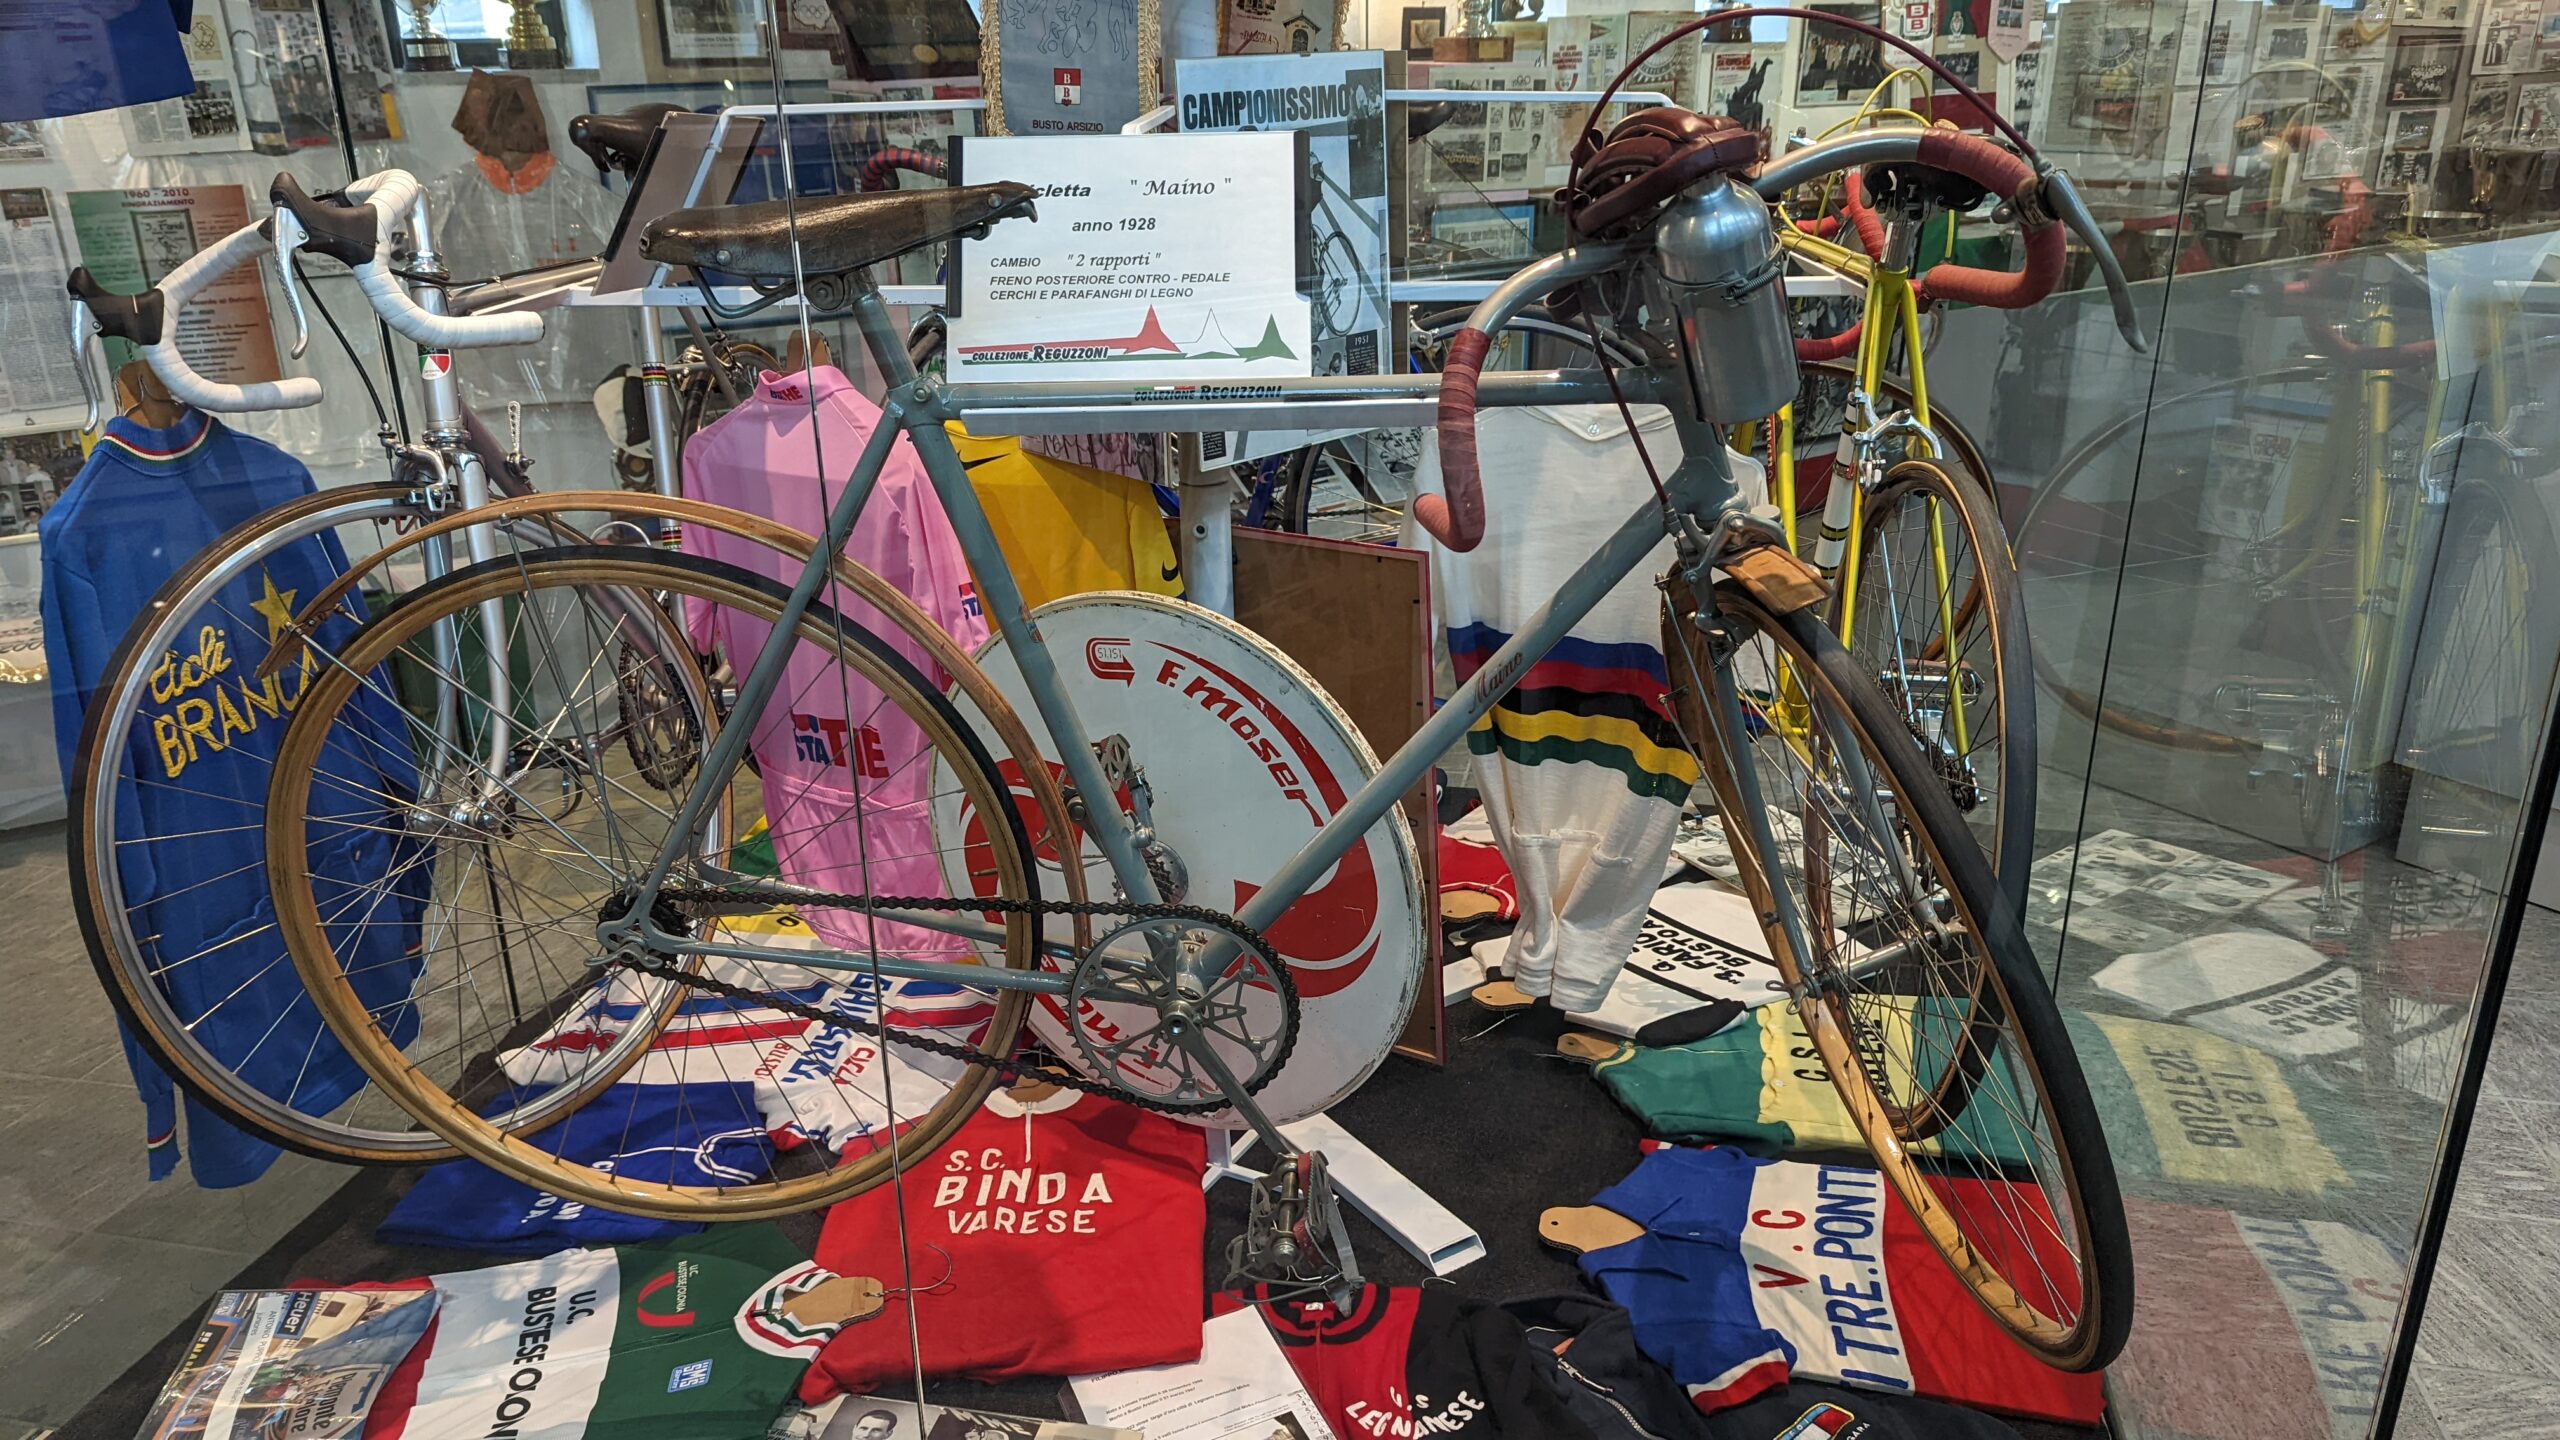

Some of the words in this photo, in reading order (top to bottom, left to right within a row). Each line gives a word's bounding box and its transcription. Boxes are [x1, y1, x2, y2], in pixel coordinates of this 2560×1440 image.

[1910, 3, 1925, 16] B
[1911, 19, 1924, 30] B
[1063, 72, 1072, 84] B
[1063, 86, 1071, 97] B
[1183, 83, 1348, 130] CAMPIONISSIMO
[1032, 119, 1064, 131] BUSTO
[1067, 121, 1104, 132] ARSIZIO
[1143, 179, 1215, 196] Maino
[1072, 219, 1113, 232] anno
[1118, 217, 1156, 231] 1928
[990, 257, 1041, 268] CAMBIO
[1089, 252, 1151, 271] rapporti
[990, 276, 1032, 286] FRENO
[1035, 275, 1115, 285] POSTERIORE
[1118, 274, 1171, 284] CONTRO
[1181, 272, 1230, 283] PEDALE
[990, 289, 1036, 300] CERCHI
[1040, 289, 1048, 299] E
[1051, 288, 1132, 299] PARAFANGHI
[1135, 287, 1148, 298] DI
[1150, 287, 1193, 298] LEGNO
[1354, 334, 1369, 346] 1951
[972, 350, 1028, 362] COLLEZIONE
[1134, 389, 1196, 401] COLLEZIONE
[933, 1167, 1113, 1207] BINDA
[948, 1206, 1096, 1235] VARESE
[285, 1291, 312, 1333] Heuer
[566, 1289, 597, 1325] U.C.
[513, 1286, 557, 1365] BUSTESE
